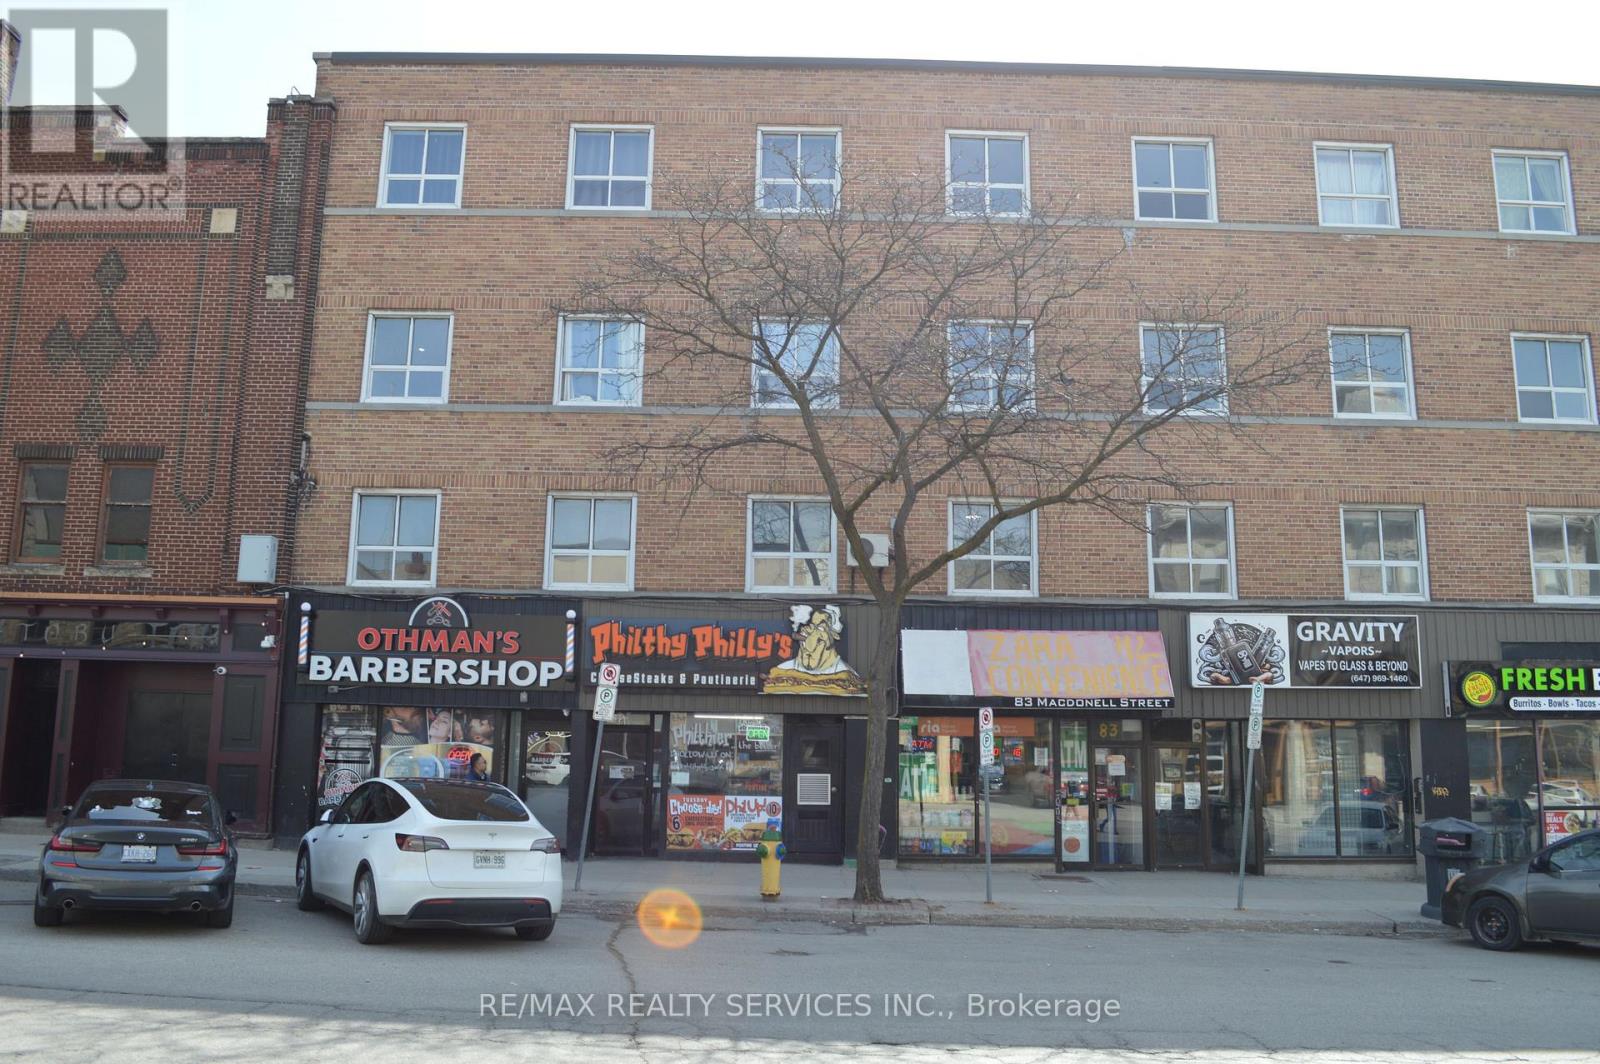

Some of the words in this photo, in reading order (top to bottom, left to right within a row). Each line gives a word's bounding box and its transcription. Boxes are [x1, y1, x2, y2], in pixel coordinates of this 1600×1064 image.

[1296, 621, 1404, 642] GRAVITY
[357, 627, 520, 655] OTHMAN'S
[590, 620, 688, 664] Philthy
[691, 625, 793, 660] Philly's
[309, 655, 563, 688] BARBERSHOP
[1299, 660, 1326, 671] VAPES
[1326, 660, 1338, 671] TO
[1339, 660, 1367, 671] GLASS
[1367, 661, 1375, 671] &
[1375, 661, 1408, 672] BEYOND
[590, 671, 674, 685] CseSteaks
[679, 673, 687, 685] &
[693, 673, 756, 686] Poutinerie
[1350, 675, 1371, 684] (647)
[1501, 667, 1586, 691] FRESH
[1014, 698, 1033, 707] 83
[1037, 698, 1117, 708] MACDONELL
[1120, 698, 1171, 708] STREET
[1513, 699, 1542, 708] Burritos
[1548, 699, 1569, 708] Bowls
[1576, 699, 1596, 708] Tacos
[920, 721, 941, 733] ria
[1099, 723, 1119, 738] 83
[747, 730, 768, 739] OPEN
[912, 739, 933, 749] ATM
[448, 750, 472, 761] OPEN
